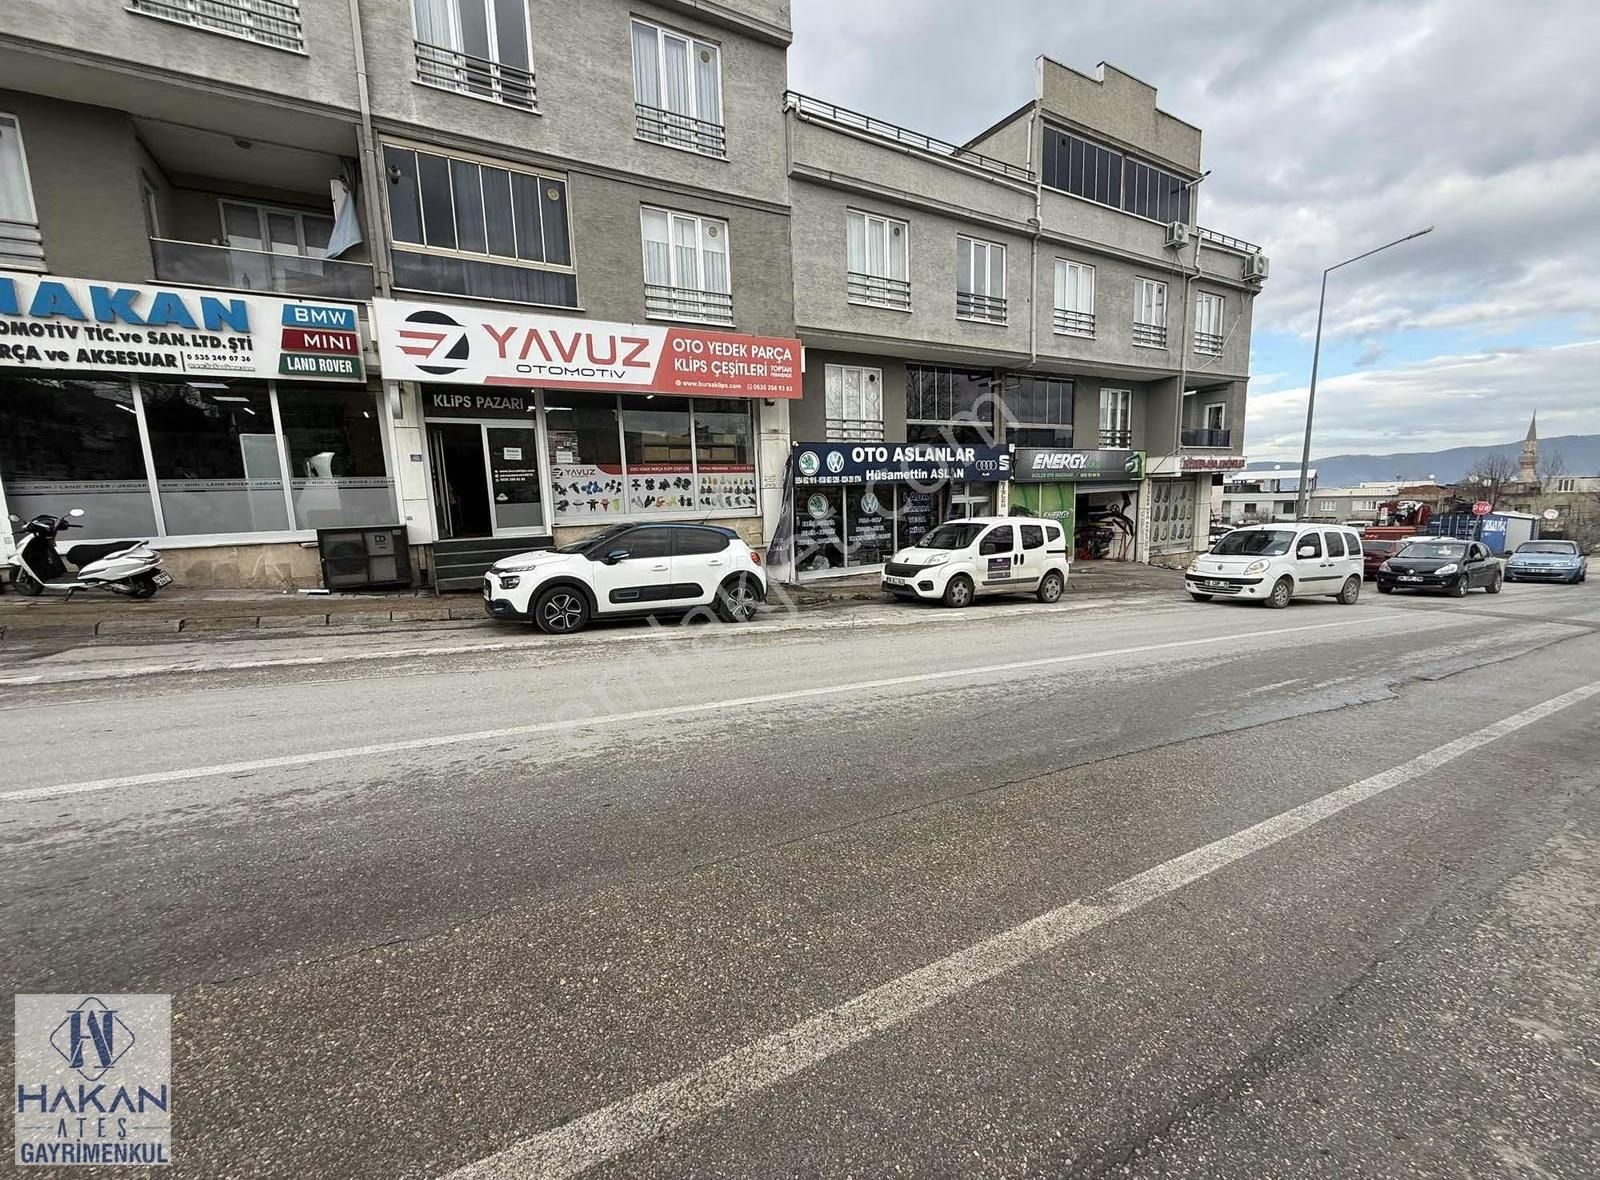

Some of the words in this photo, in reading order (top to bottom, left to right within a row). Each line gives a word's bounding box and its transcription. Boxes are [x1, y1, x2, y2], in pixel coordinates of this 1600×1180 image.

[294, 307, 347, 326] BMW
[304, 333, 352, 350] MINI
[482, 323, 651, 368] YAVUZ
[672, 338, 704, 354] OTO
[707, 341, 748, 358] YEDEK
[751, 344, 792, 362] PARÇA
[44, 349, 70, 362] ve
[76, 348, 179, 368] AKSESUAR
[287, 356, 317, 371] LAND
[320, 358, 353, 373] ROVER
[674, 356, 708, 373] KLİPS
[711, 359, 768, 379] ÇEŞİTLERİ
[682, 380, 742, 390] www.bursaklips.com
[476, 396, 524, 410] PAZARI
[852, 447, 888, 462] OTO
[892, 447, 975, 462] ASLANLAR
[565, 468, 595, 476] YAVUZ
[866, 469, 928, 481] Hüsamettin
[903, 492, 929, 501] LADA
